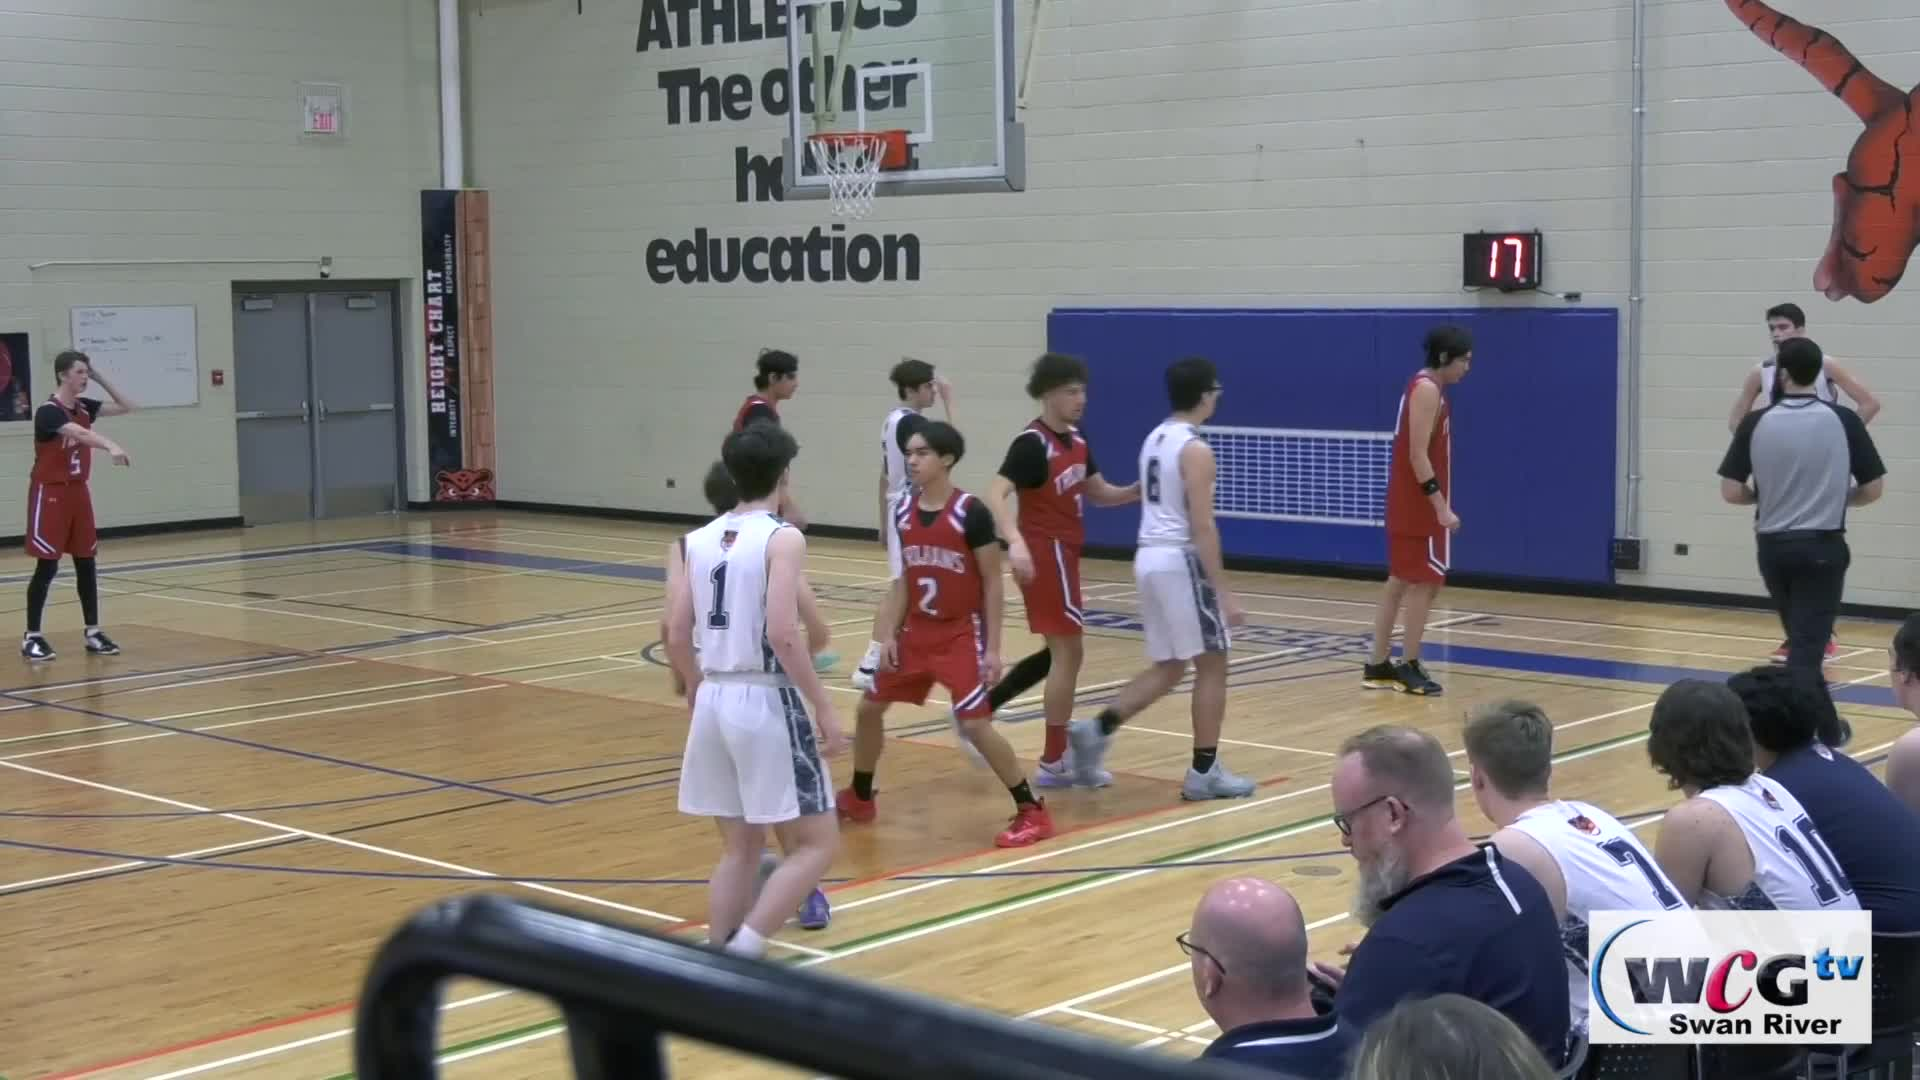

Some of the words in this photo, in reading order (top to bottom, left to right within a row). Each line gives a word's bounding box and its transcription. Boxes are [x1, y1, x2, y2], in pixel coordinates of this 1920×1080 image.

[658, 67, 753, 125] The
[761, 57, 918, 115] other
[645, 223, 921, 284] education
[1489, 238, 1522, 278] 17
[427, 269, 444, 333] CHART
[429, 343, 447, 413] HEIGHT
[707, 561, 730, 630] 1
[917, 577, 938, 616] 2
[1596, 836, 1683, 911] 7
